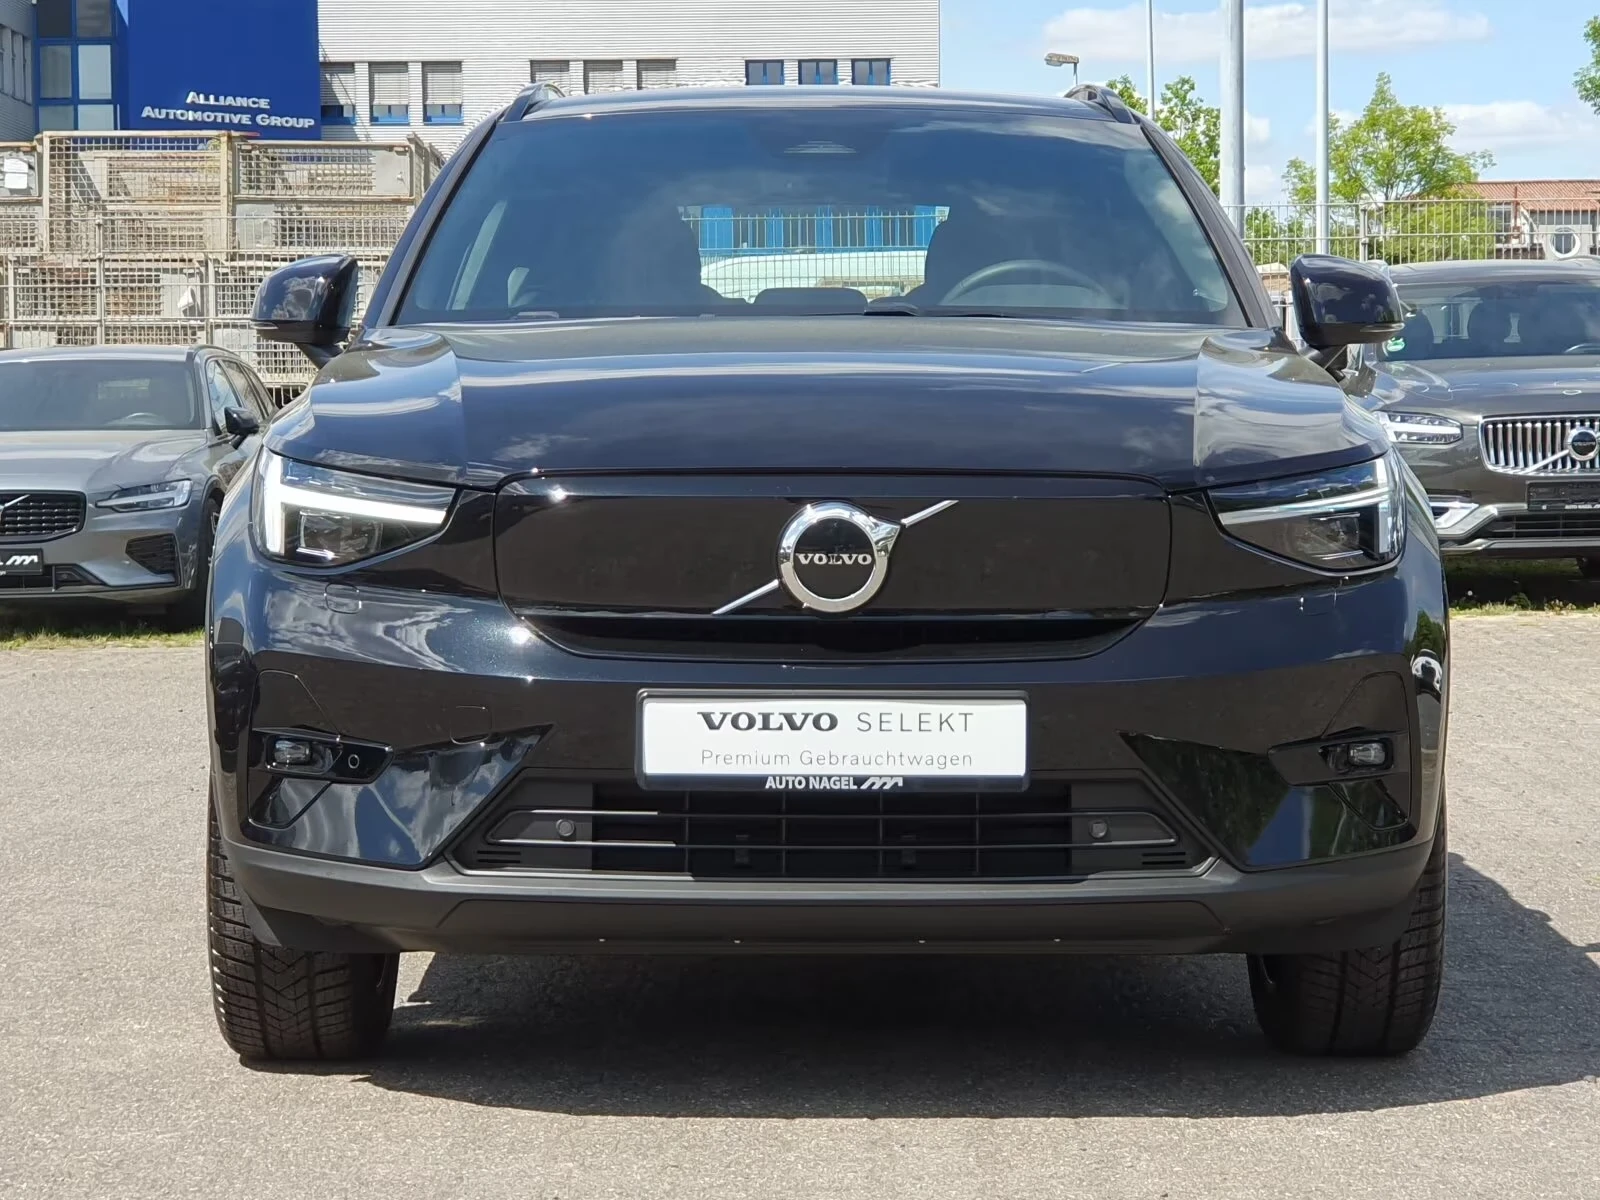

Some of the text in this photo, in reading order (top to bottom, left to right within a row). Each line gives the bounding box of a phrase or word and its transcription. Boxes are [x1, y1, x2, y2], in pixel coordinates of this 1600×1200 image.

[186, 91, 271, 109] ALLIANCE
[141, 106, 315, 128] AUTOMOTIVE GROUP
[796, 553, 873, 565] VOLVO
[697, 711, 975, 733] VOLVO SELEKT
[701, 749, 973, 770] Premium Gebrauchtwagen
[765, 776, 857, 790] AUTO NAGEL
